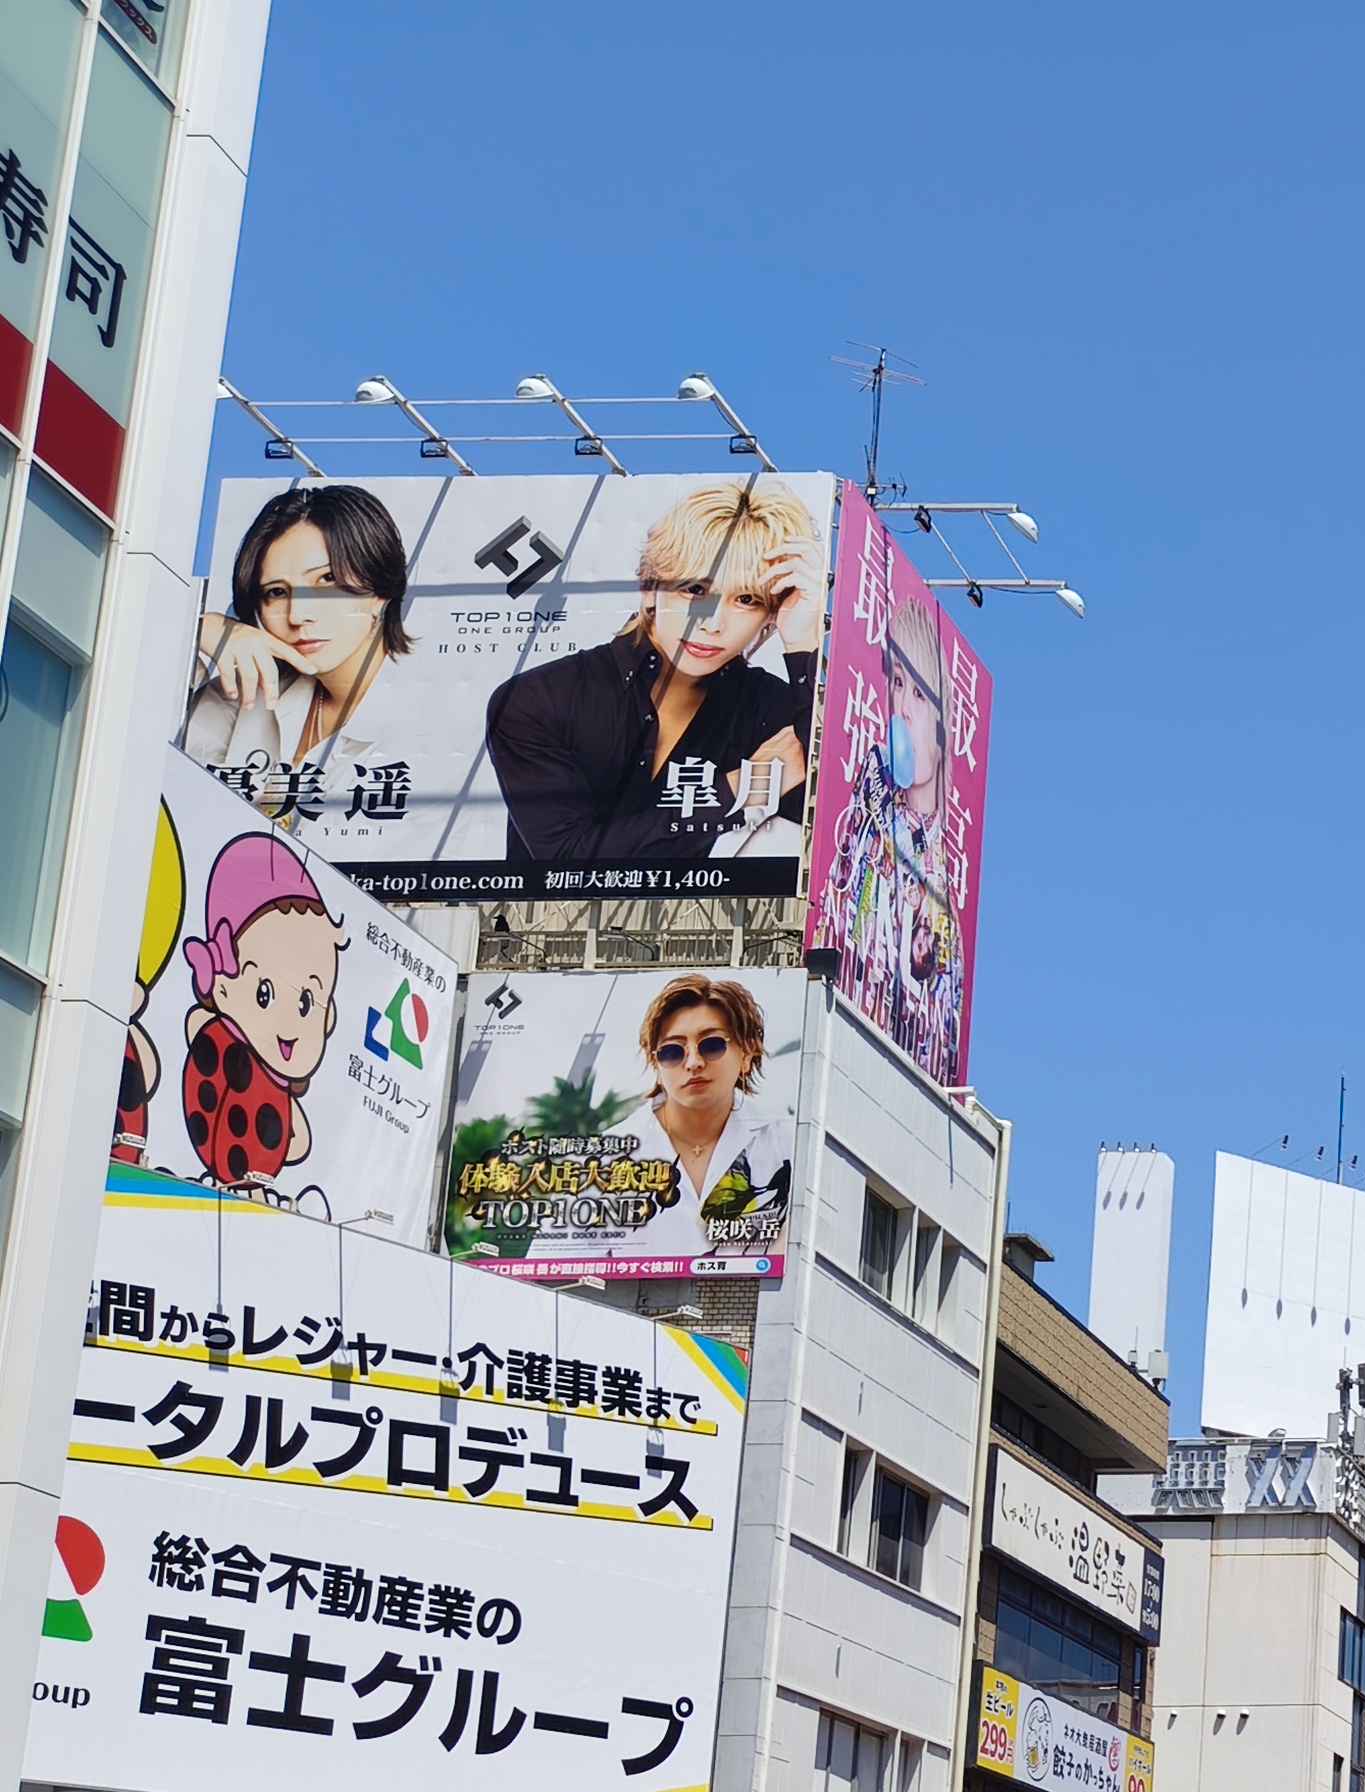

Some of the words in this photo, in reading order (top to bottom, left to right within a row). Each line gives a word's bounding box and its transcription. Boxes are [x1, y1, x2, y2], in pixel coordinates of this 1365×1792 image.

[438, 643, 499, 654] HOST
[517, 642, 577, 653] CLUB
[458, 626, 492, 635] ONE
[502, 626, 561, 634] GROUP
[323, 826, 384, 836] Yumi
[670, 819, 773, 833] Satsuki
[366, 921, 446, 993] 総合不動産業の
[348, 1053, 431, 1120] 富士グループ
[363, 1095, 383, 1118] FUJI
[385, 1109, 410, 1134] Group
[459, 1160, 674, 1195] 体験入店大歓迎
[480, 1198, 648, 1229] TOP1ONE
[73, 1379, 699, 1522] ータルプロデュース
[149, 1531, 522, 1645] 総合不動産業の
[139, 1614, 694, 1776] 富士グループ
[986, 1693, 1014, 1717] 生ビール
[1064, 1723, 1108, 1758] ネオ大衆居酒屋
